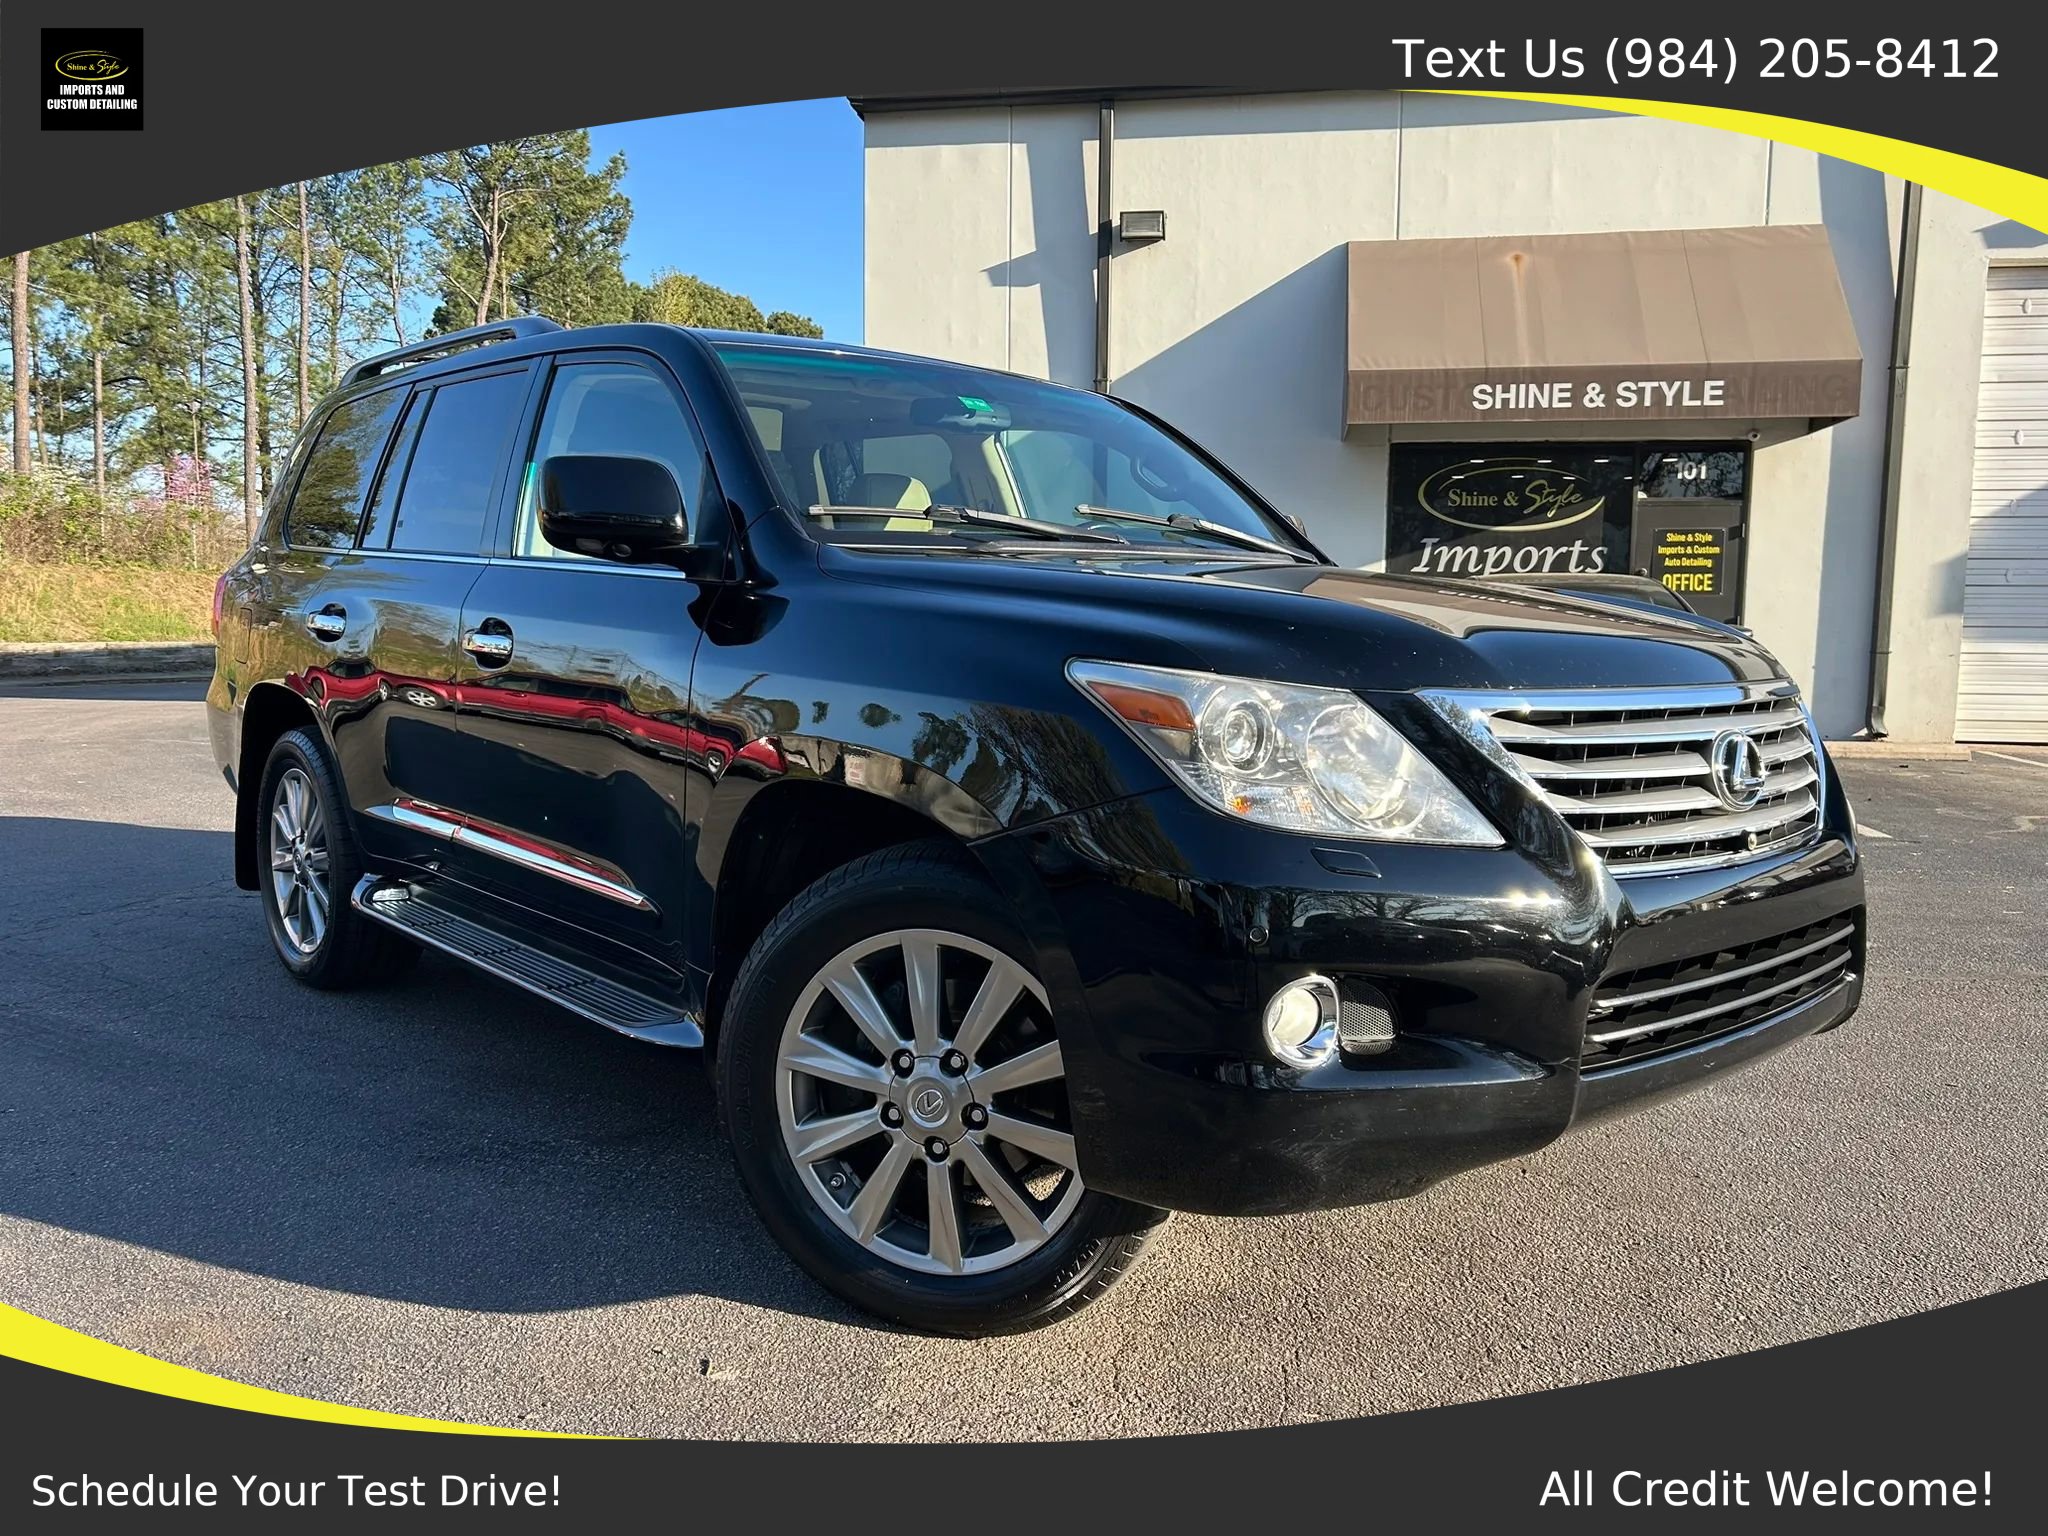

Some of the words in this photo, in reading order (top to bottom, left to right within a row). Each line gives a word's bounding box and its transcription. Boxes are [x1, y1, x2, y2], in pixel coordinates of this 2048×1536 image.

[1471, 382, 1573, 410] SHINE
[1582, 381, 1606, 408] &
[1615, 379, 1726, 408] STYLE
[1675, 461, 1707, 480] 101
[1447, 488, 1498, 508] Shine
[1503, 490, 1520, 507] &
[1523, 479, 1584, 519] Style
[1666, 532, 1686, 542] Shine
[1686, 533, 1694, 542] &
[1694, 532, 1713, 543] Style
[1410, 537, 1608, 575] Imports
[1657, 545, 1685, 555] Imports
[1686, 545, 1693, 554] &
[1693, 545, 1721, 555] Custom
[1663, 557, 1681, 567] Auto
[1681, 557, 1713, 568] Detailing
[1661, 573, 1714, 591] OFFICE
